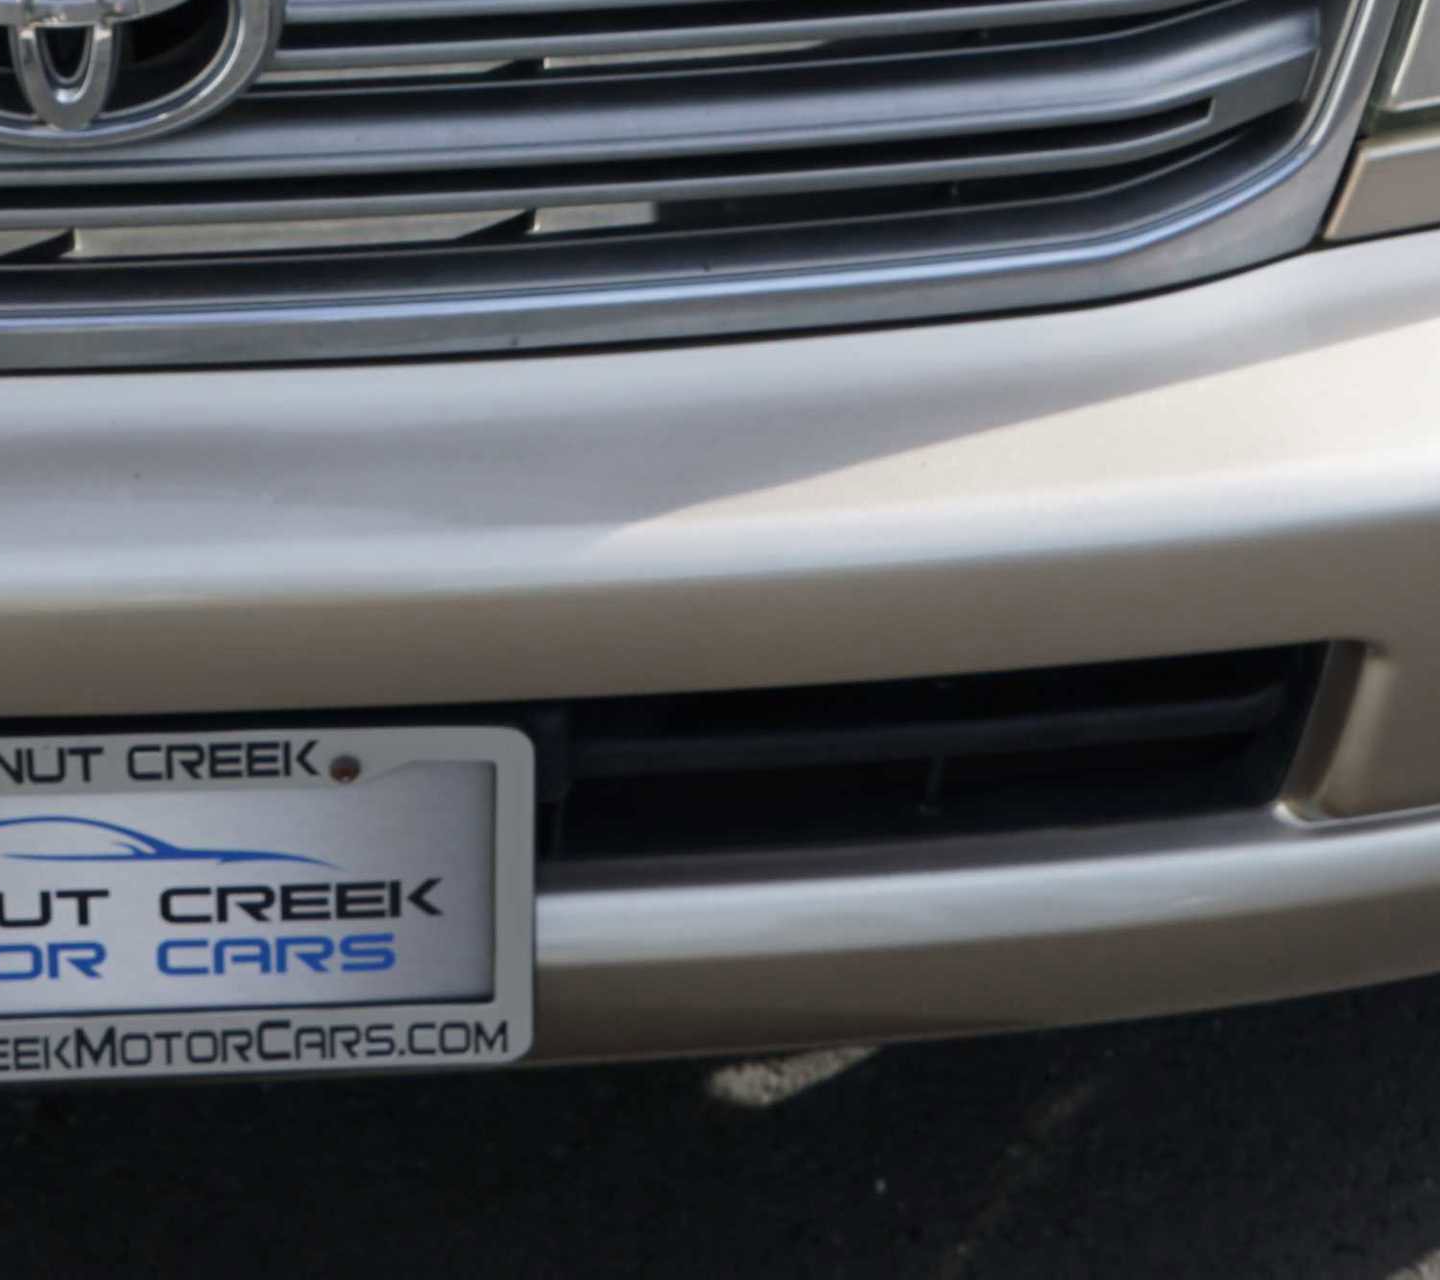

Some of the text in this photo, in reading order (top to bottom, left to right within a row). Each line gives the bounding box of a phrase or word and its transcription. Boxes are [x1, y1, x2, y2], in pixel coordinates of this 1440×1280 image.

[127, 739, 320, 782] CREEK
[159, 877, 446, 927] CREEK
[155, 933, 397, 977] CARS
